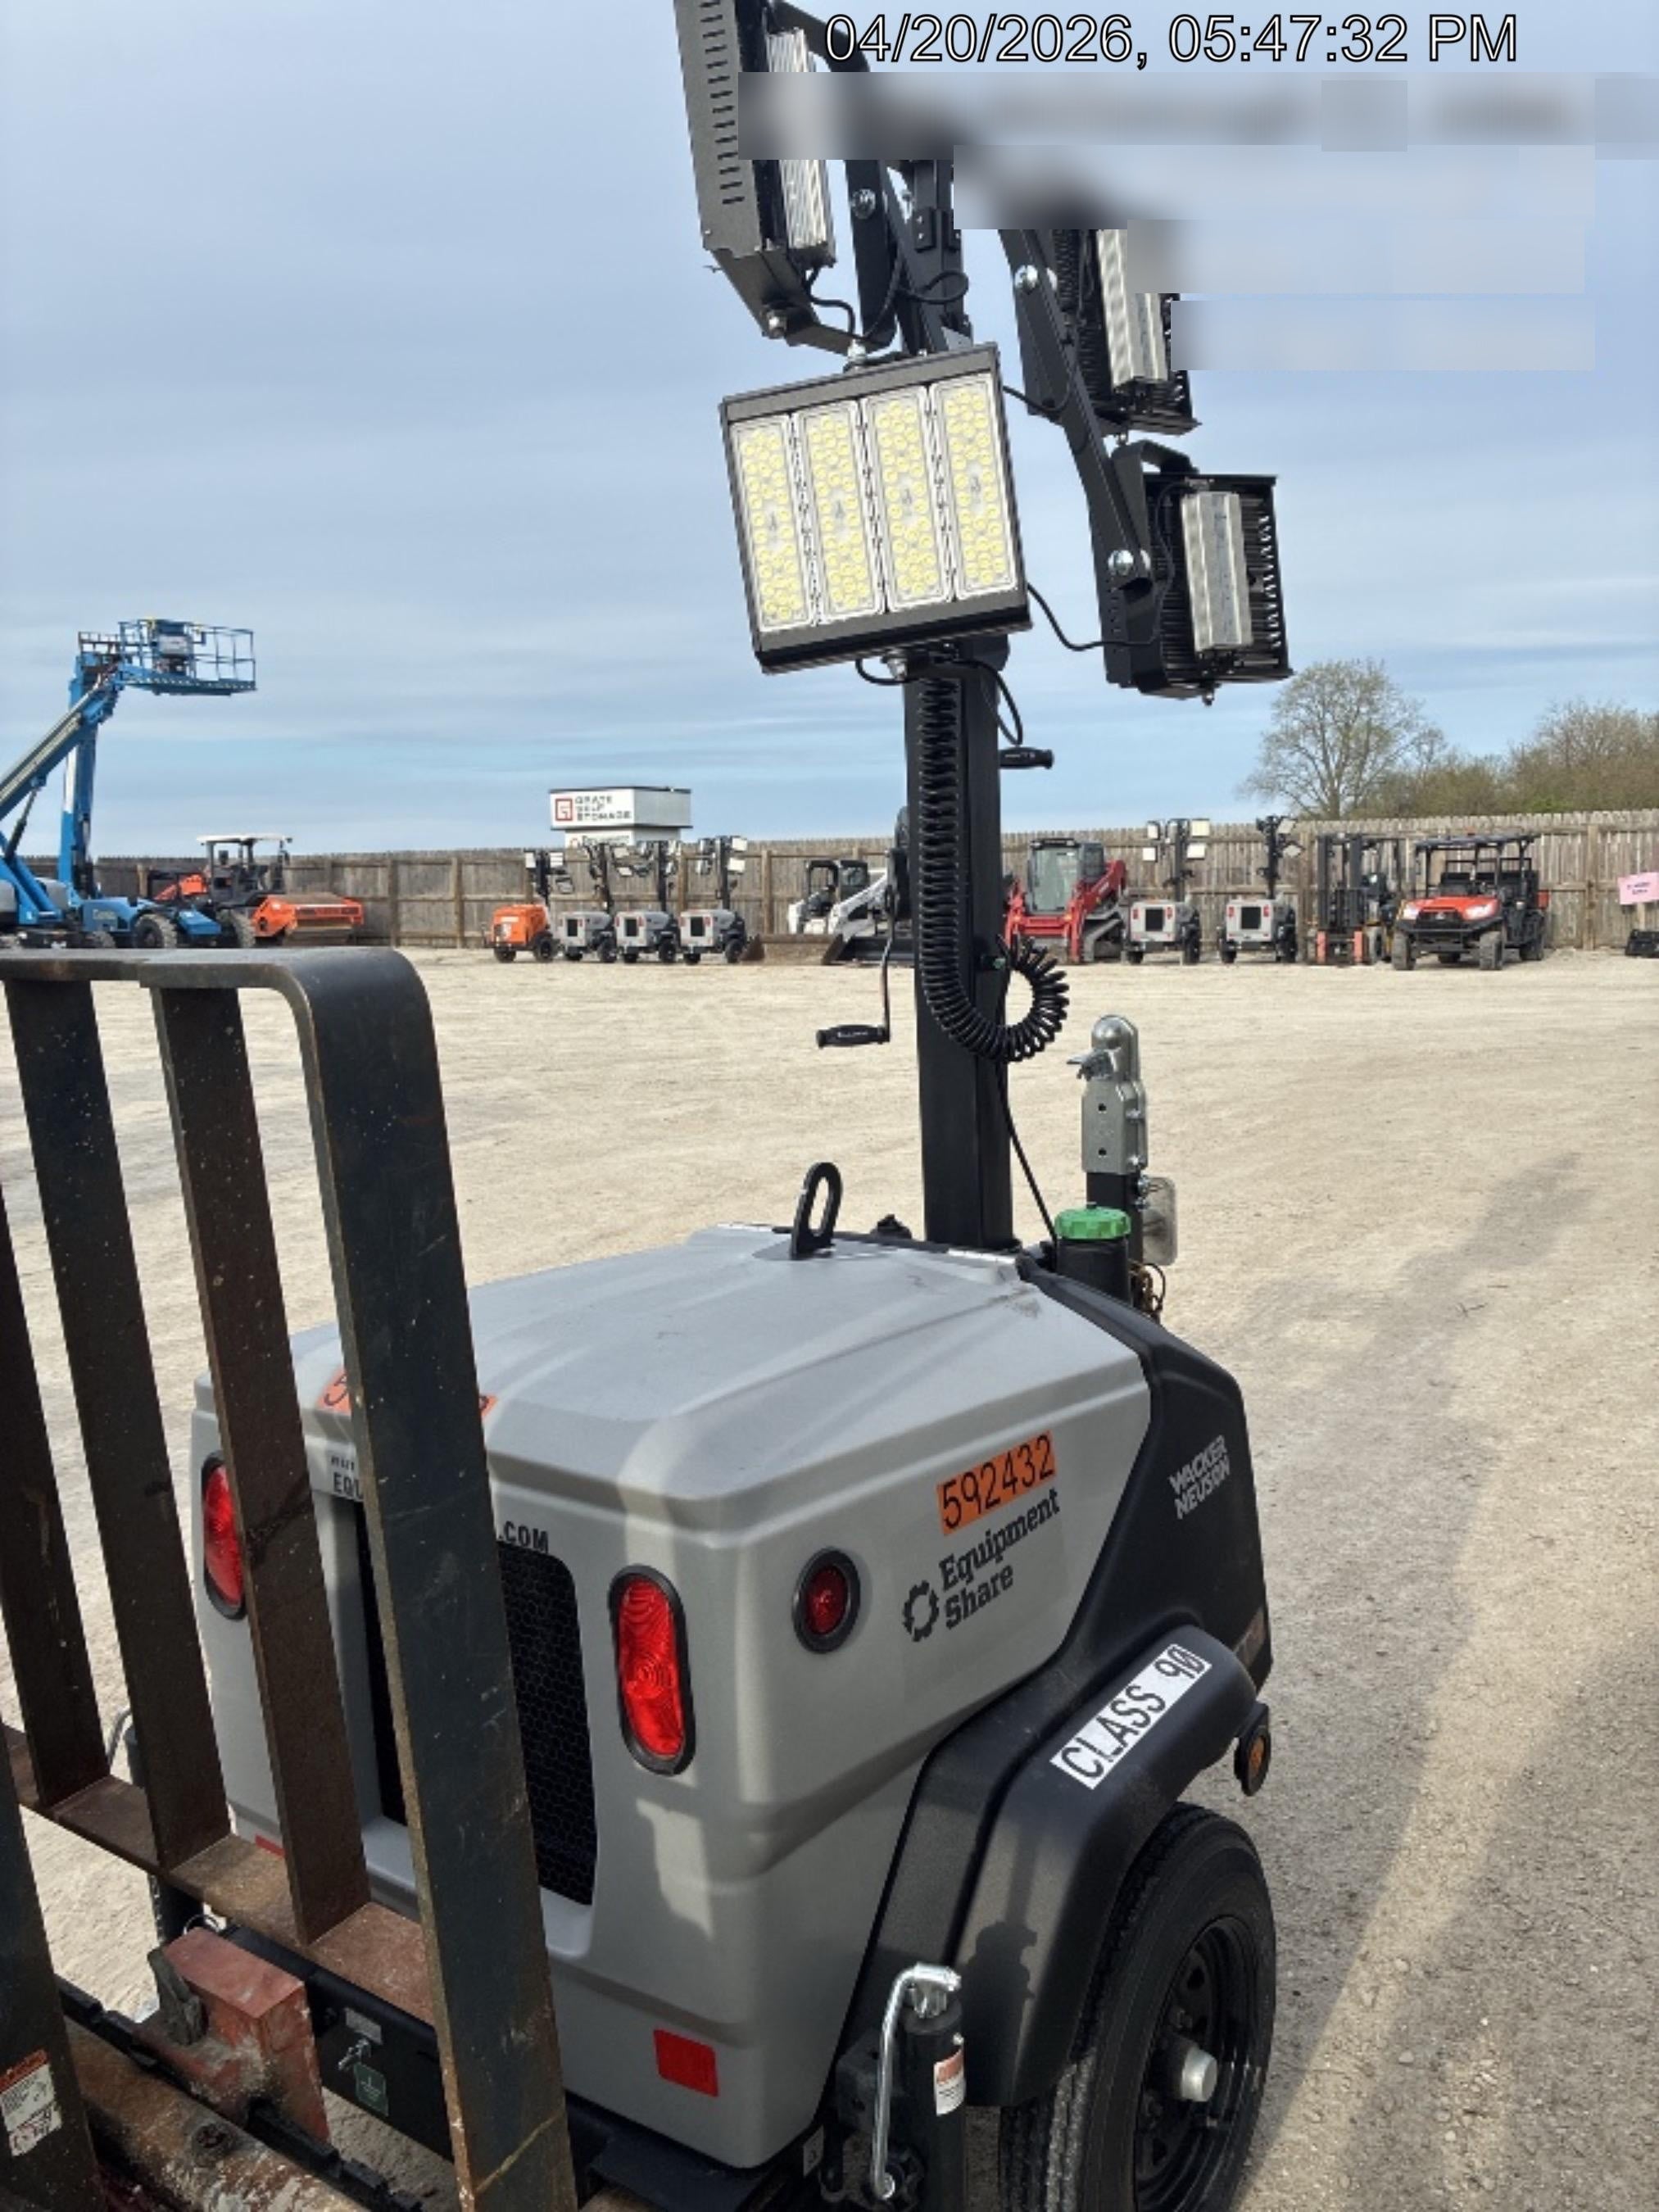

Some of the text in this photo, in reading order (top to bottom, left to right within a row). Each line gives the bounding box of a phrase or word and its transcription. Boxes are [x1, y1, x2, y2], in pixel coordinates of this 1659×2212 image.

[943, 1435, 1054, 1530] 592432
[1167, 1435, 1227, 1494] WACKER
[1175, 1454, 1230, 1520] NEUSON
[939, 1487, 1060, 1592] Equipment
[945, 1564, 1013, 1630] Share
[1061, 1684, 1165, 1779] CLASS
